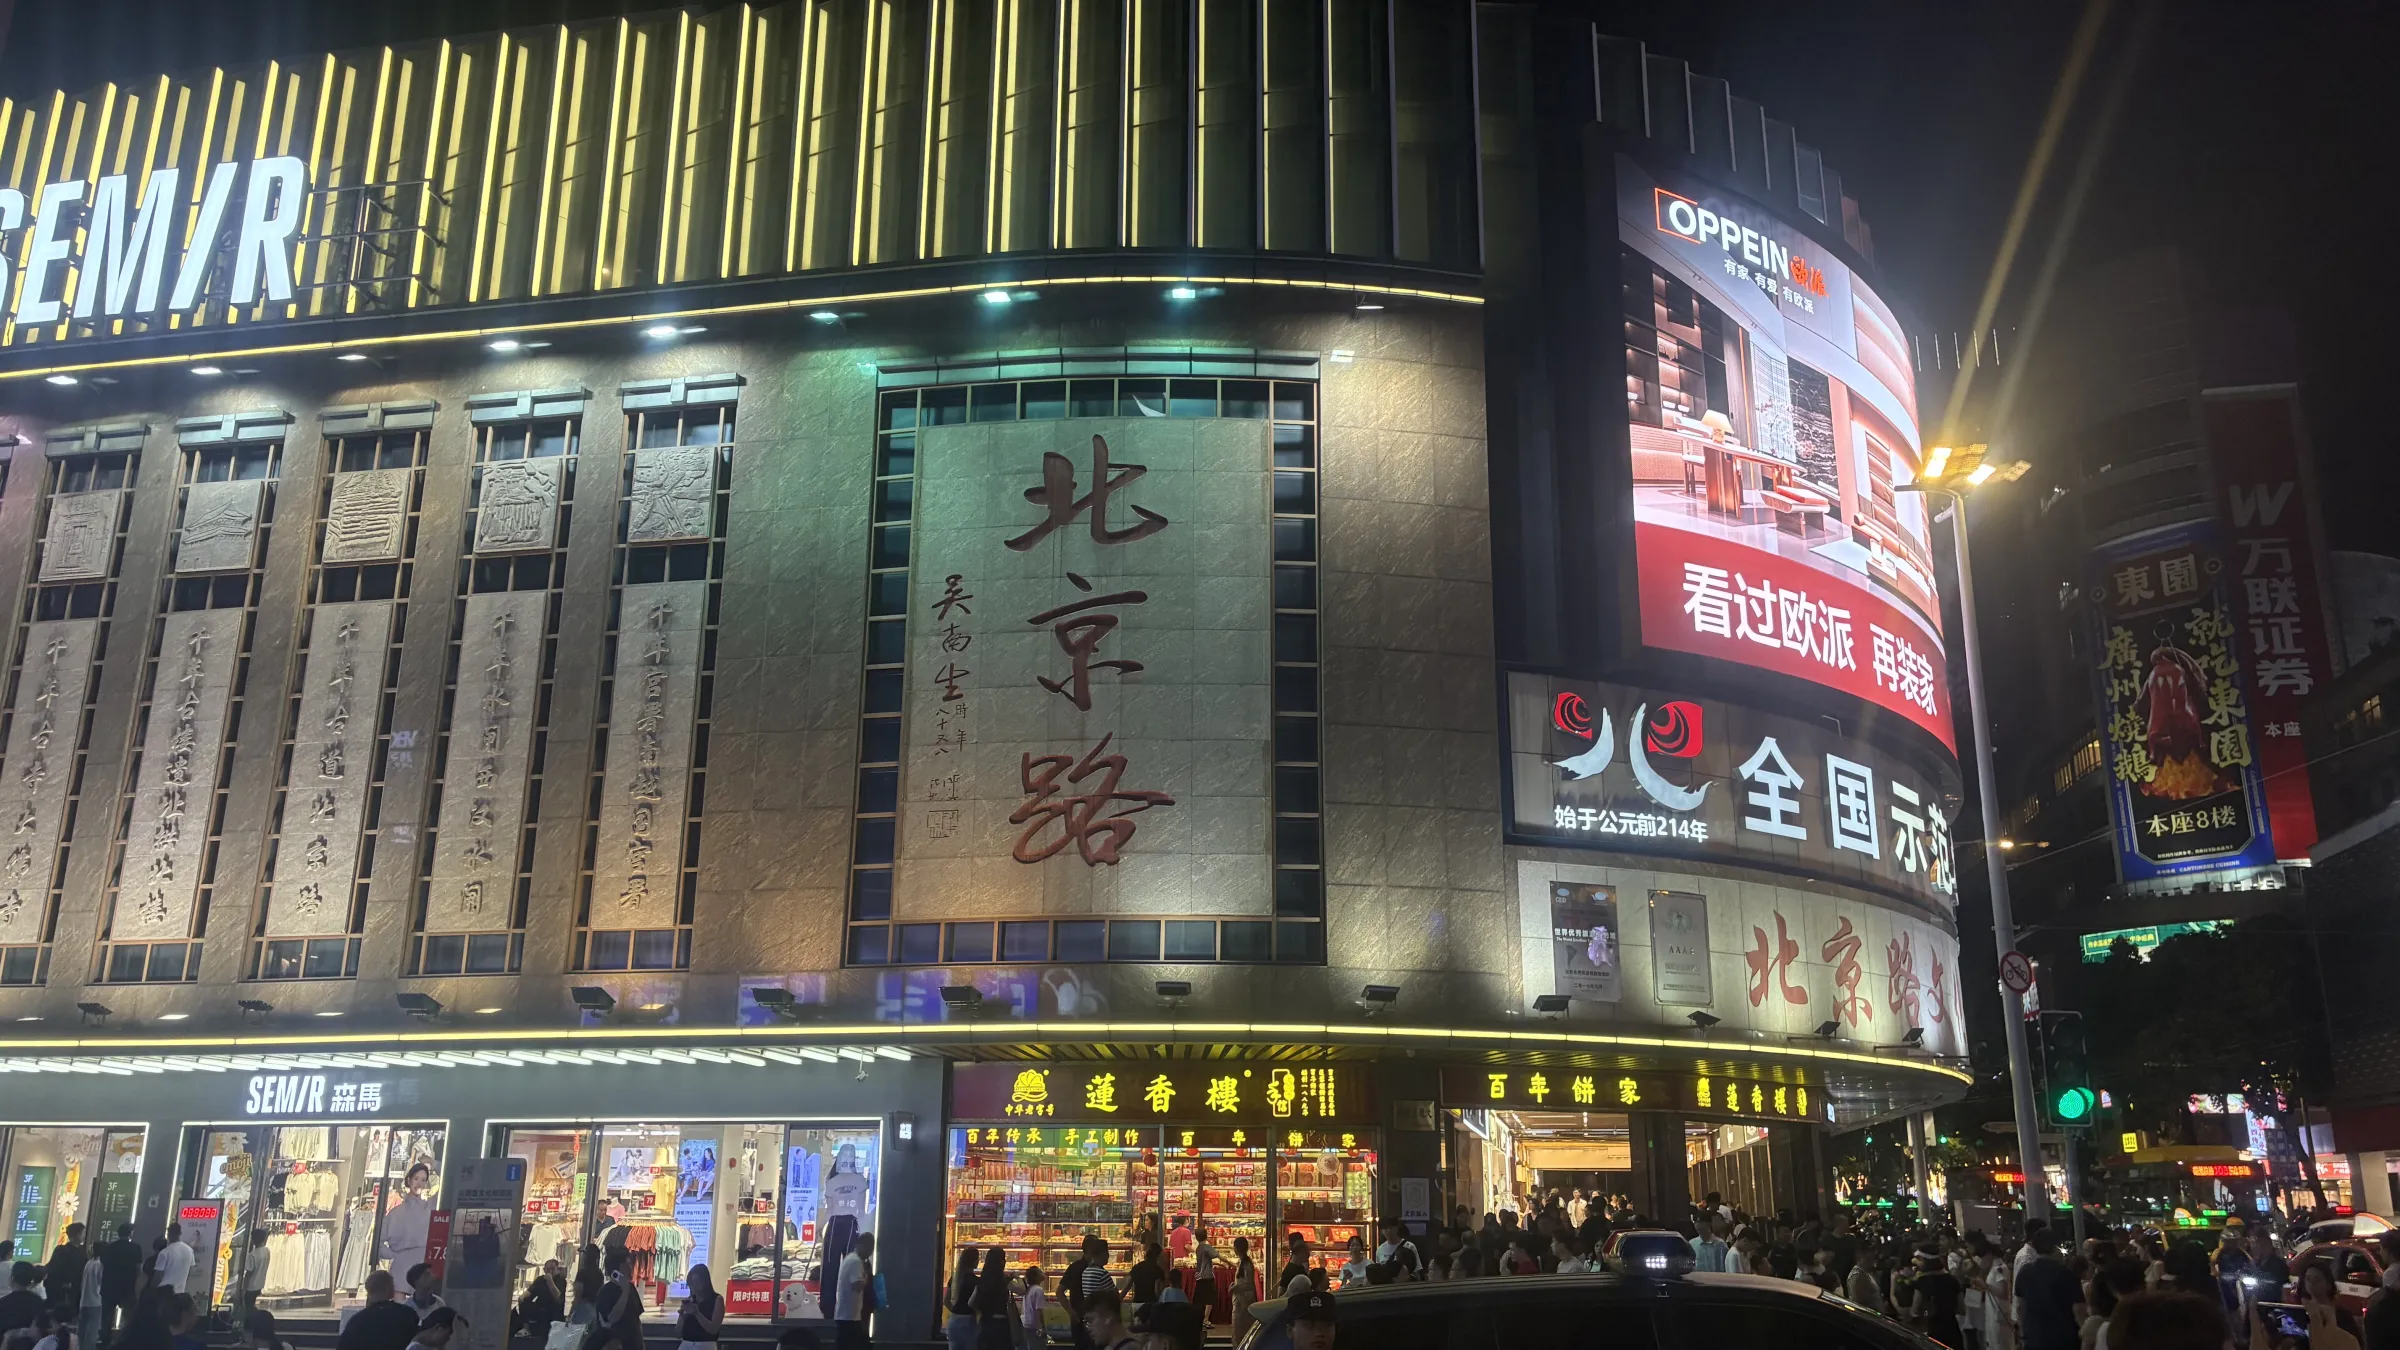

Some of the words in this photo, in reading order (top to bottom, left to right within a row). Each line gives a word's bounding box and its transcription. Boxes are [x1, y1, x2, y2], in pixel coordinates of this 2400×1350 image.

[1669, 201, 1789, 279] OPPEIN
[1724, 258, 1749, 281] 有家
[1755, 272, 1778, 295] 有爱
[1783, 286, 1814, 315] 有欧派
[2238, 537, 2314, 697] 万联证券
[1003, 433, 1176, 867] 北京路
[1683, 562, 1857, 671] 看过欧派
[1869, 622, 1938, 717] 再装家
[2264, 721, 2301, 738] 本座
[1554, 805, 1708, 843] 始于公元前214年
[1738, 736, 1959, 905] 全国示范
[2146, 805, 2236, 837] 本座8楼
[1745, 909, 1966, 1045] 北京路文
[246, 1075, 326, 1113] SEMIR
[330, 1082, 382, 1112] 森馬
[1005, 1103, 1054, 1116] 中华老字号
[1085, 1072, 1240, 1113] 蓮香樓
[966, 1127, 1042, 1145] 百年传承
[1064, 1128, 1139, 1146] 手工制作
[23, 1174, 34, 1182] 3F
[107, 1182, 118, 1190] 3F
[18, 1210, 28, 1218] 2F
[101, 1221, 112, 1229] 2F
[732, 1290, 770, 1302] 限时特惠
